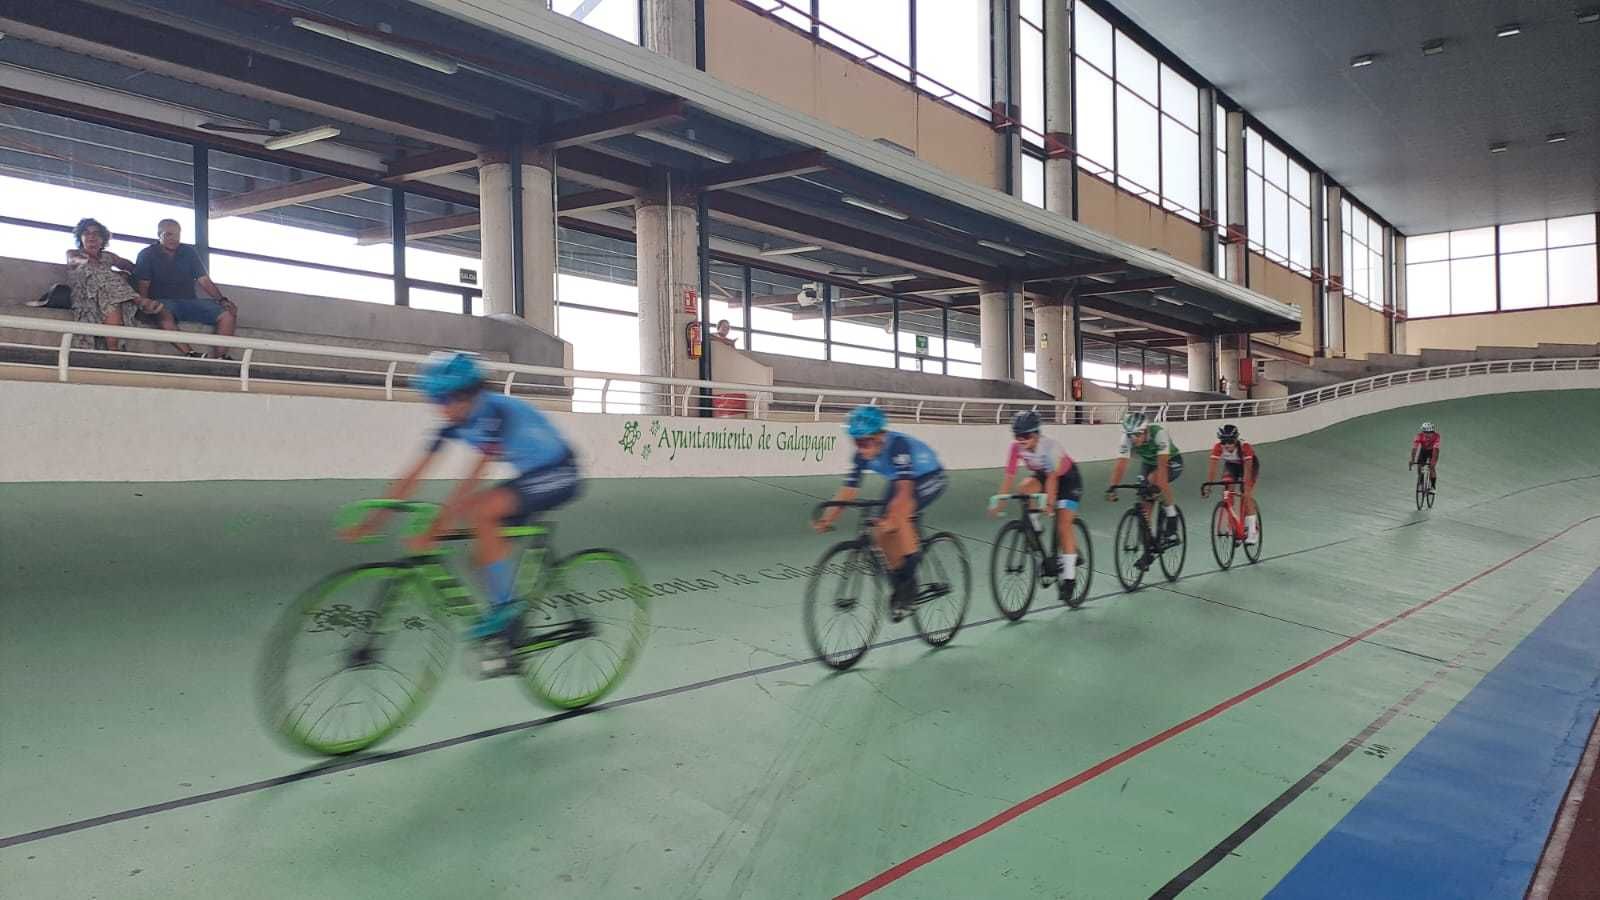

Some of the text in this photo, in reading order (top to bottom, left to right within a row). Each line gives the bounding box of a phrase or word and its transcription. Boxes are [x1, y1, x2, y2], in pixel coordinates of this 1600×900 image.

[657, 424, 837, 462] Ayuntamiento de Galapagar
[711, 568, 760, 587] de
